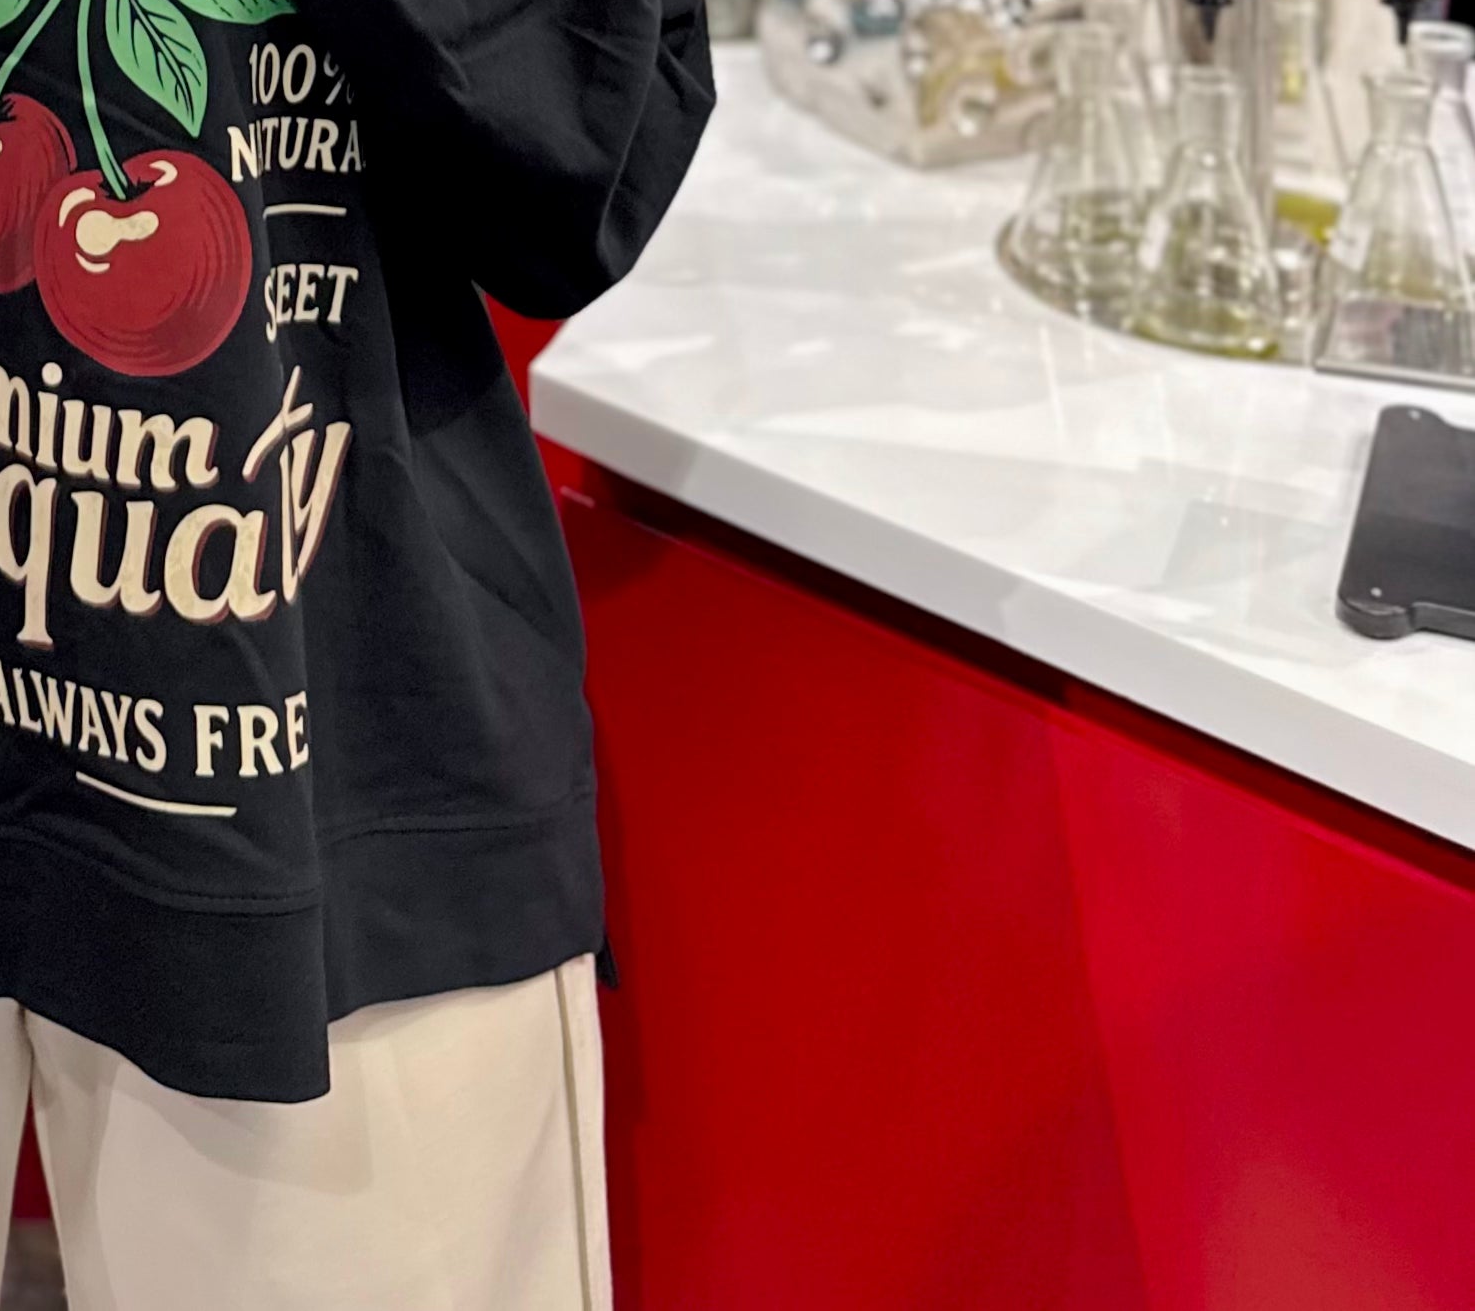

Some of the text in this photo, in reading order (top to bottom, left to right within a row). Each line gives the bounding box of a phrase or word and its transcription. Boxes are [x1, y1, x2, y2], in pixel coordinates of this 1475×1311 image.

[227, 115, 367, 183] NTURA
[264, 263, 360, 343] SEET
[192, 690, 310, 777] FRE
